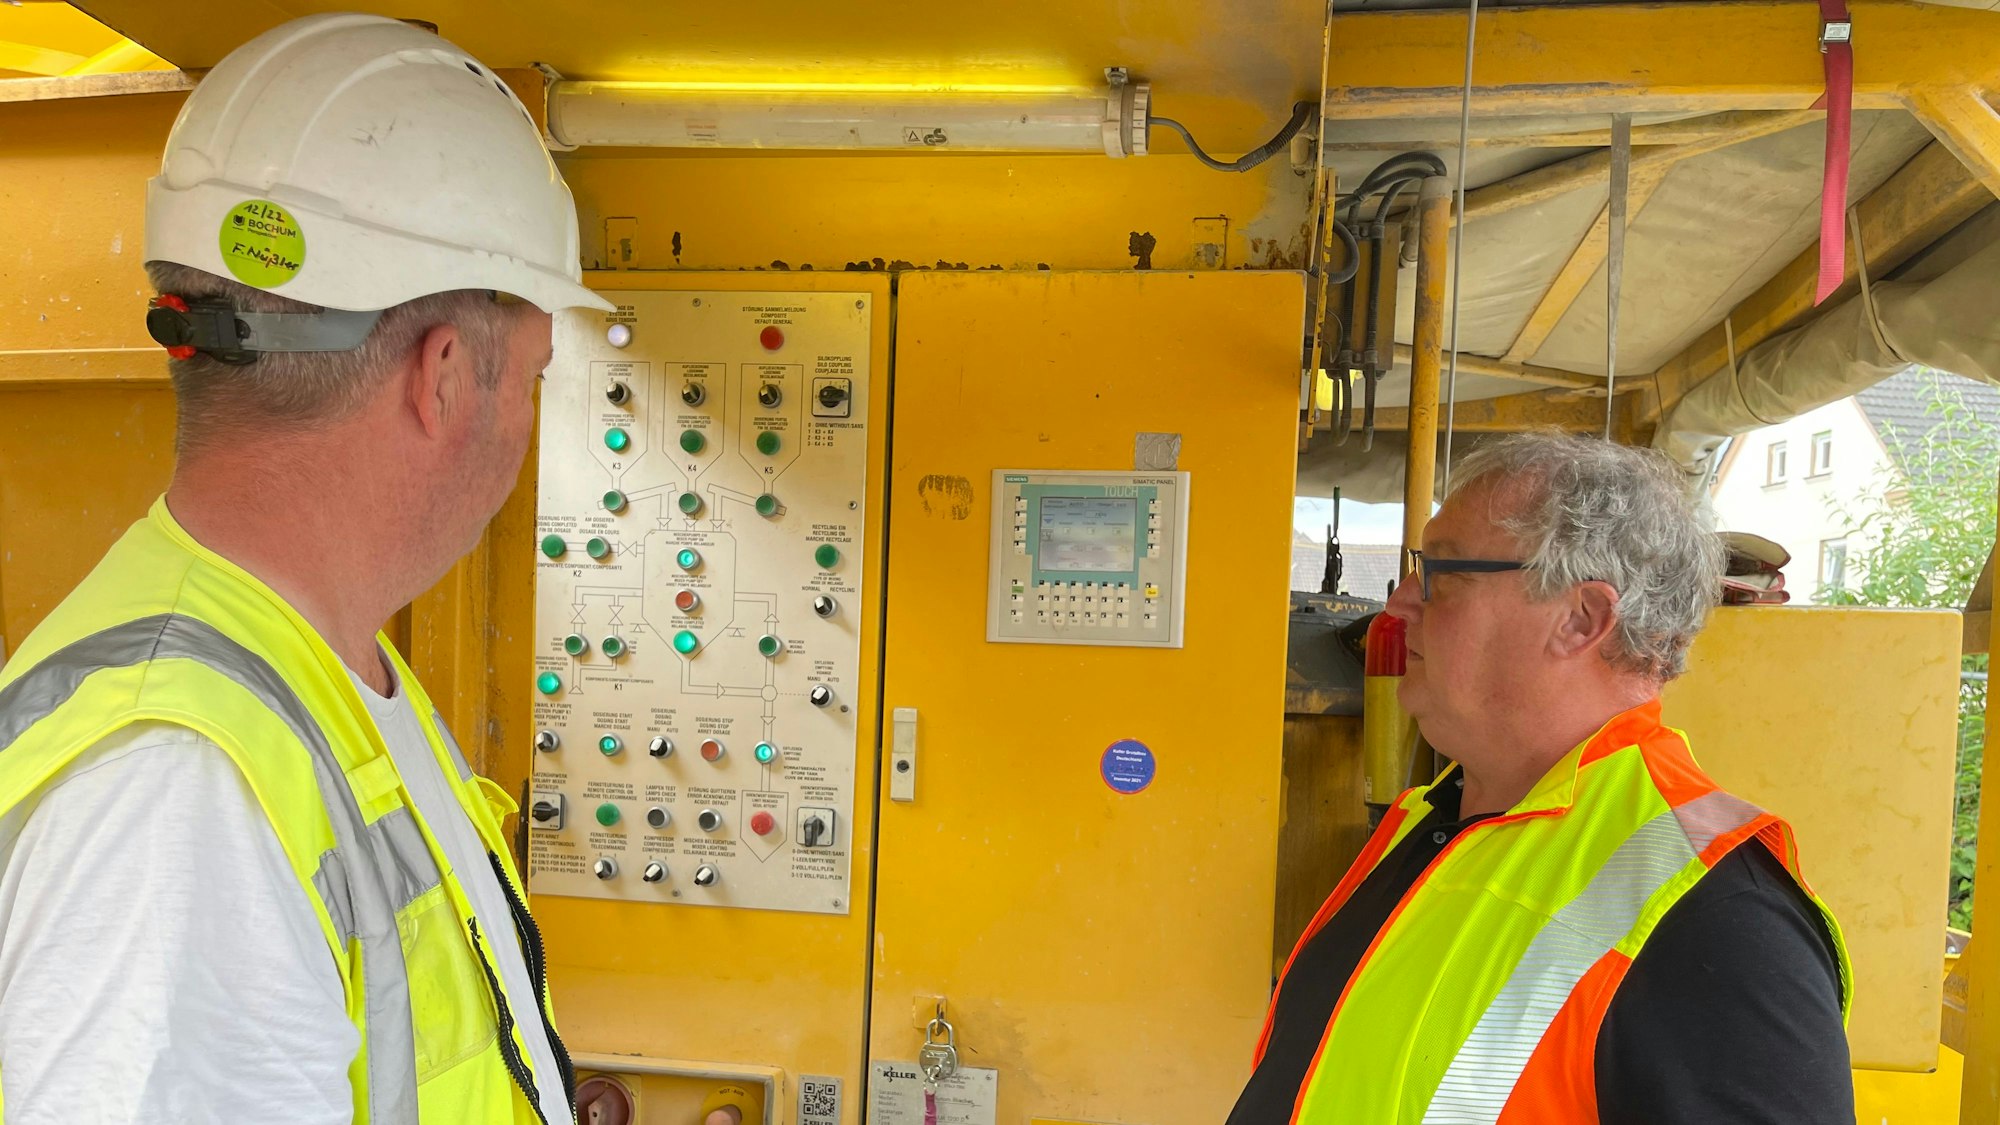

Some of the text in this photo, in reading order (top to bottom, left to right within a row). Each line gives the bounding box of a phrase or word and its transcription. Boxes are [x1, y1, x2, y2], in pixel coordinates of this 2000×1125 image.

[243, 204, 285, 223] 12/22
[249, 219, 296, 238] BOCHUM
[688, 464, 697, 472] K4
[1104, 485, 1138, 497] TOUCH
[883, 1069, 917, 1081] KELLER
